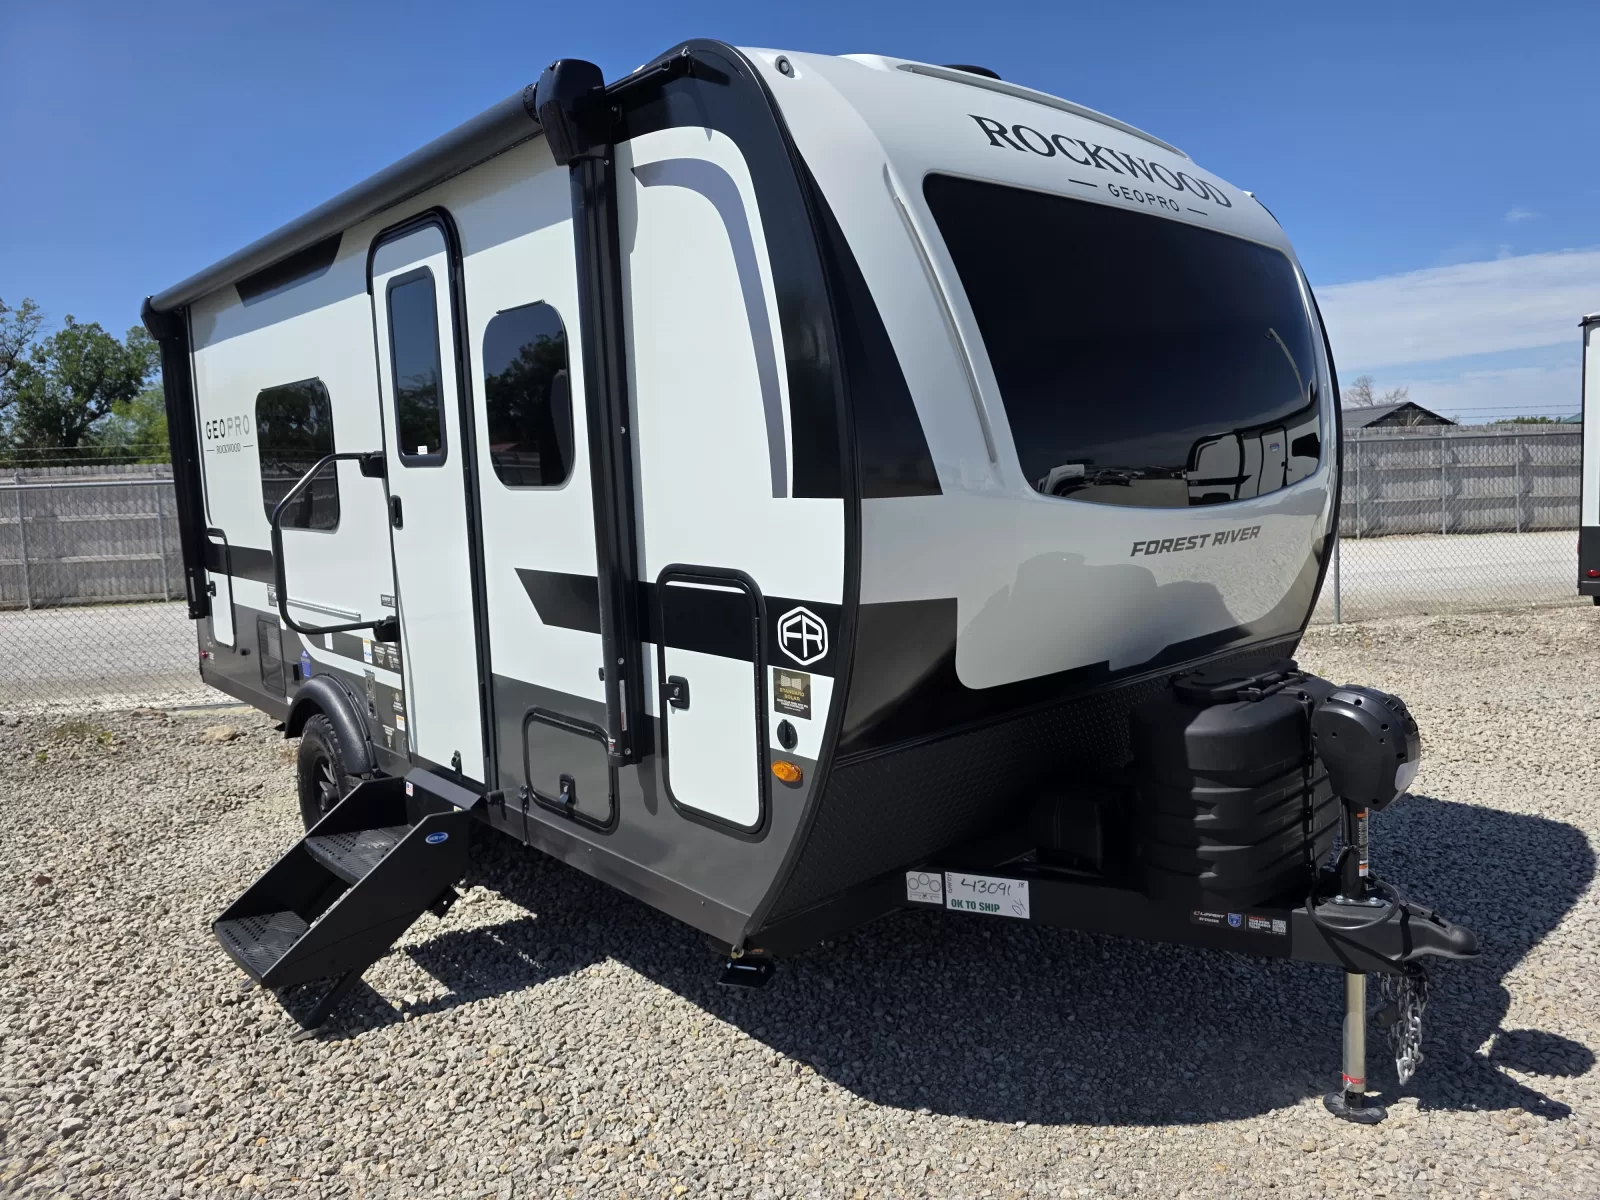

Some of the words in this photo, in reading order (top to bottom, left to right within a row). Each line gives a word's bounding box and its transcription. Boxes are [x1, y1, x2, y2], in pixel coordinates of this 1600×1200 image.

[967, 113, 1233, 209] ROCKWOOD
[1107, 183, 1180, 212] GEOPRO
[205, 414, 250, 440] GEOPRO
[1130, 533, 1211, 557] FOREST
[1211, 525, 1262, 547] RIVER
[961, 878, 1012, 896] 43091
[951, 898, 964, 909] OK
[965, 900, 977, 911] TO
[979, 901, 1000, 913] SHIP
